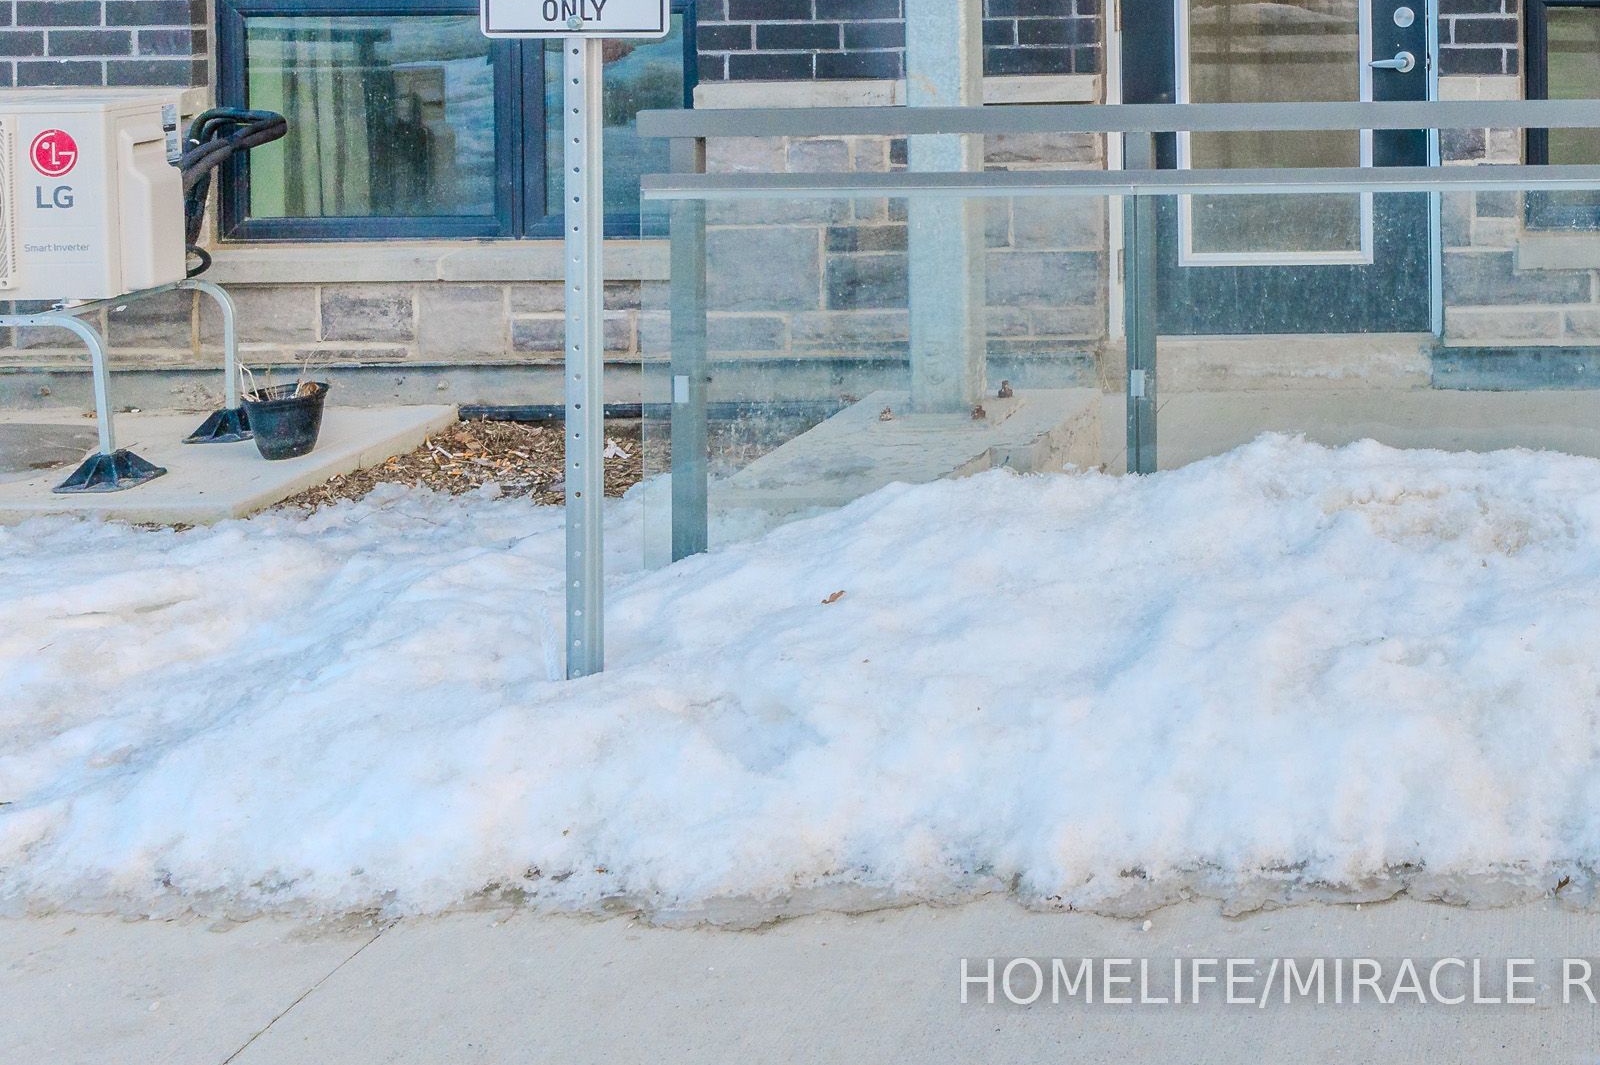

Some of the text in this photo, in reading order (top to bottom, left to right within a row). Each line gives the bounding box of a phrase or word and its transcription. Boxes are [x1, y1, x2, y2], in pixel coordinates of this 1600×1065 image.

[542, 0, 607, 22] ONLY
[36, 185, 74, 209] LG
[24, 242, 90, 253] Smart Inverter
